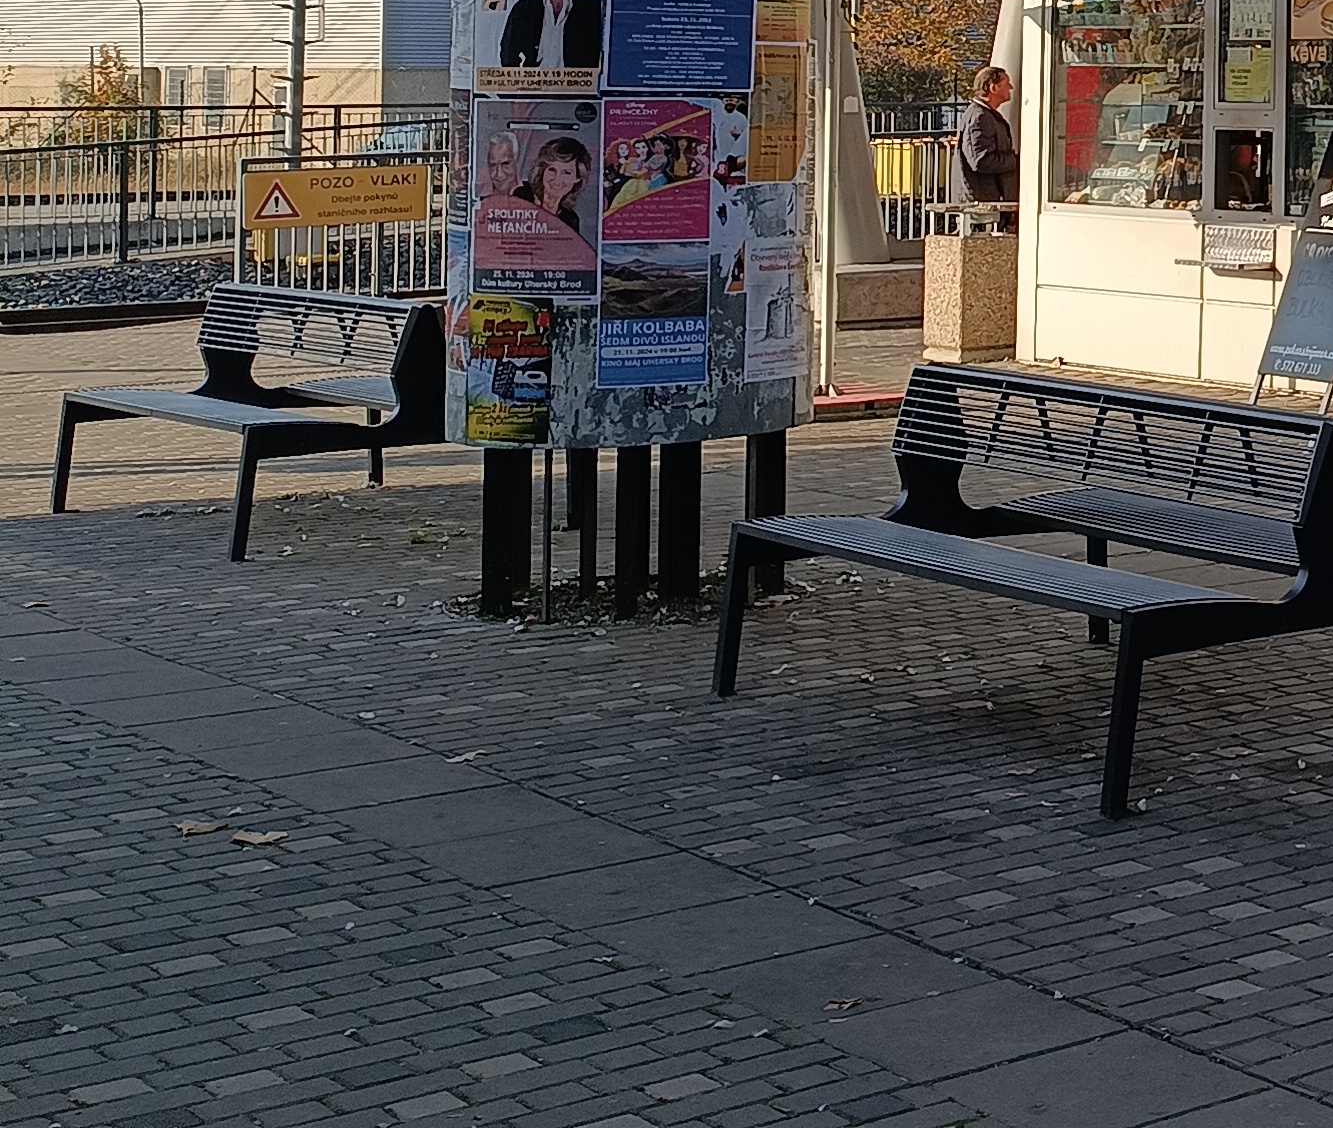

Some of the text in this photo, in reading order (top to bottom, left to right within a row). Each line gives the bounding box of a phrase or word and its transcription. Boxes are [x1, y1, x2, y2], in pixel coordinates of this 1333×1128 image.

[564, 70, 592, 78] HODIN
[527, 78, 565, 87] UHERSKÝ
[370, 173, 417, 186] VLAK!
[332, 192, 398, 204] Dbejte pokynů
[317, 205, 412, 218] staničního rozhlasu!
[524, 280, 558, 289] Uherský
[560, 280, 582, 288] Brod
[601, 319, 705, 336] JIŘÍ KOLBABA
[600, 334, 706, 346] SEDM DIVŮ ISLANDU
[601, 359, 623, 368] KINO
[681, 356, 703, 364] BROD
